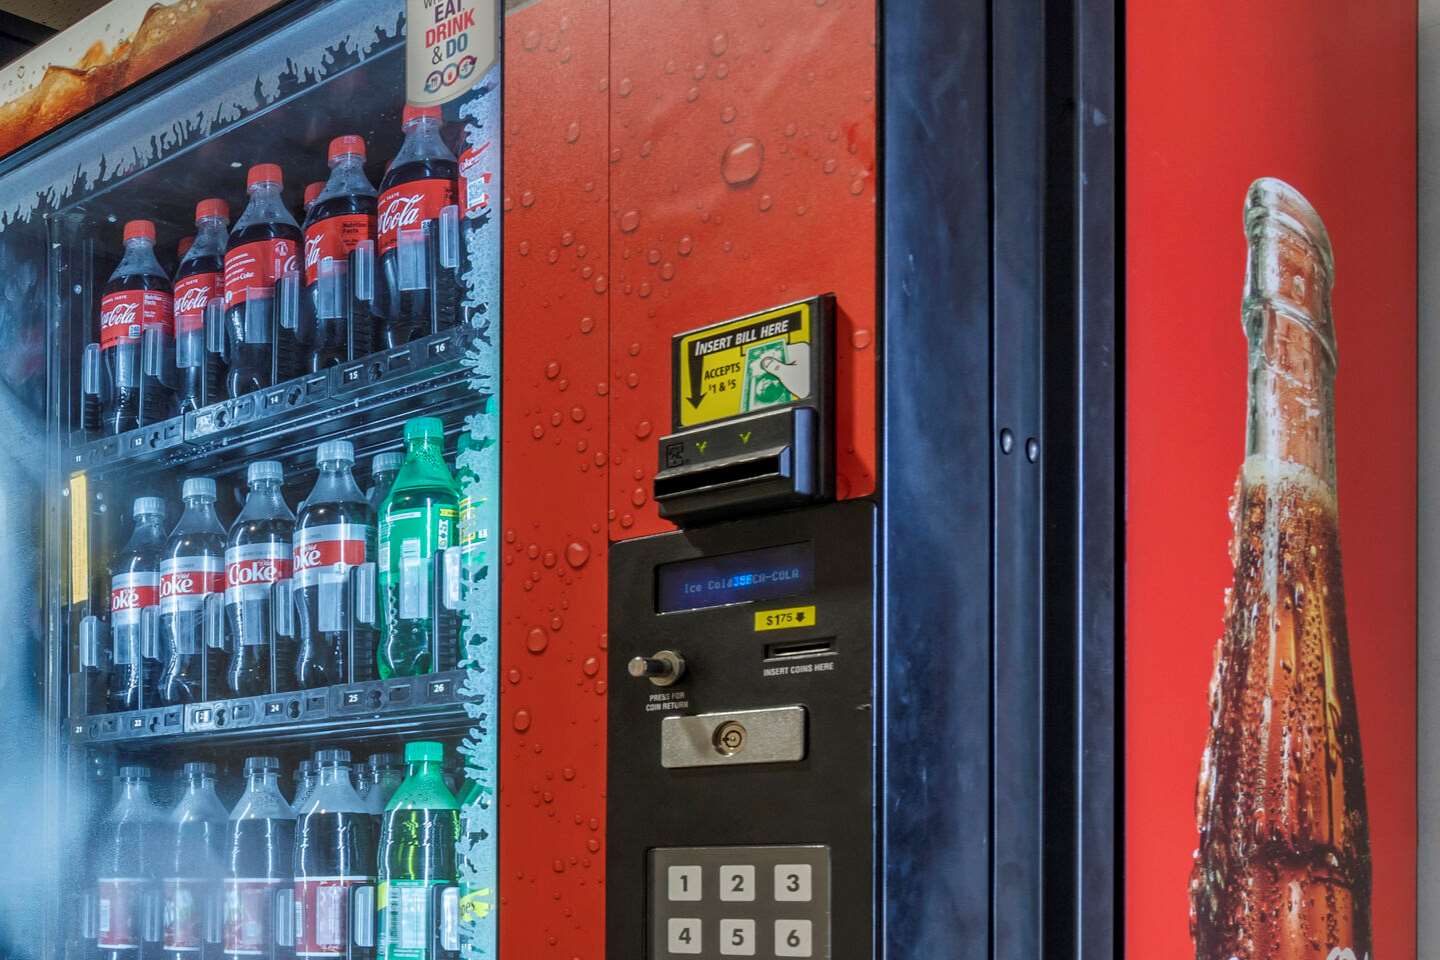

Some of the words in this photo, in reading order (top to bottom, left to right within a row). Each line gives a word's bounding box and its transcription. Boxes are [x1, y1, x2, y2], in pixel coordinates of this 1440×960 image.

[425, 8, 476, 48] DRINK
[432, 46, 442, 65] &
[446, 33, 468, 58] DO
[695, 336, 733, 357] INSERT
[735, 329, 757, 346] BILL
[760, 319, 790, 339] HERE
[349, 371, 358, 381] 15
[435, 343, 446, 353] 16
[704, 362, 741, 381] ACCEPTS
[719, 382, 726, 392] &
[229, 561, 278, 585] Coke
[112, 588, 140, 611] oke
[763, 667, 789, 677] INSERT
[790, 664, 813, 674] COINS
[814, 662, 835, 671] HERE
[348, 694, 359, 703] 25
[433, 683, 445, 693] 26
[680, 875, 688, 892] 1
[731, 874, 744, 892] 2
[786, 874, 800, 892] 3
[678, 927, 691, 944] 4
[731, 928, 744, 946] 5
[787, 929, 800, 947] 6
